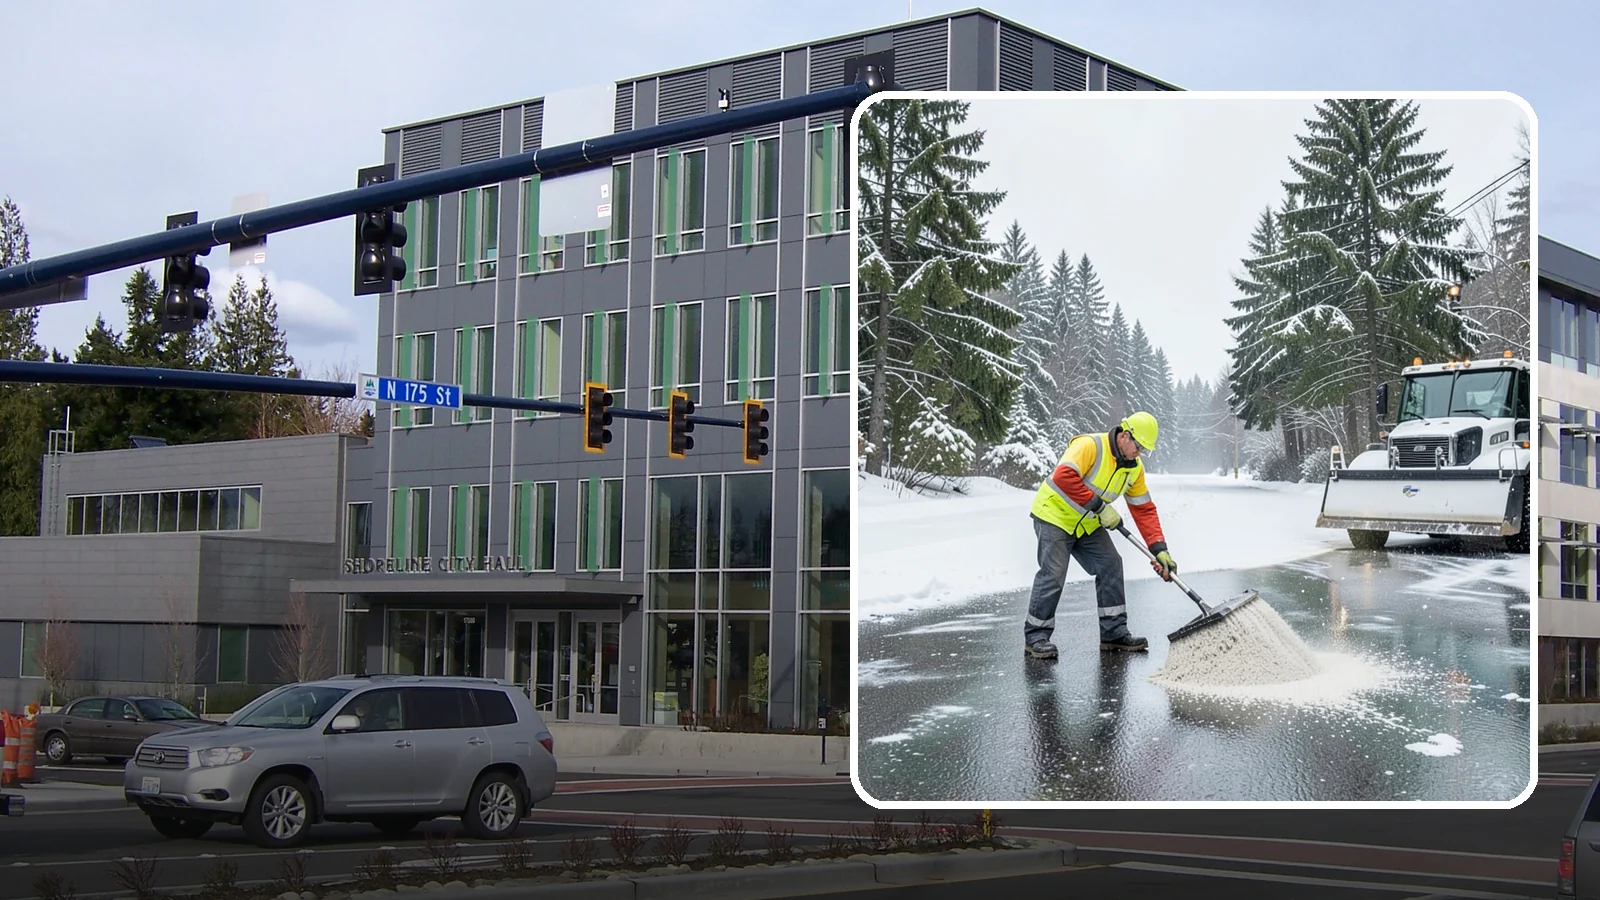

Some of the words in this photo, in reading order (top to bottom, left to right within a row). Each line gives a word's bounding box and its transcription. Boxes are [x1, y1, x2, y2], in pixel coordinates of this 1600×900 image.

[387, 381, 396, 399] N
[405, 383, 427, 403] 175
[436, 386, 451, 405] St
[344, 557, 431, 574] SHORELINE
[438, 556, 476, 572] CITY
[484, 555, 526, 571] HALL
